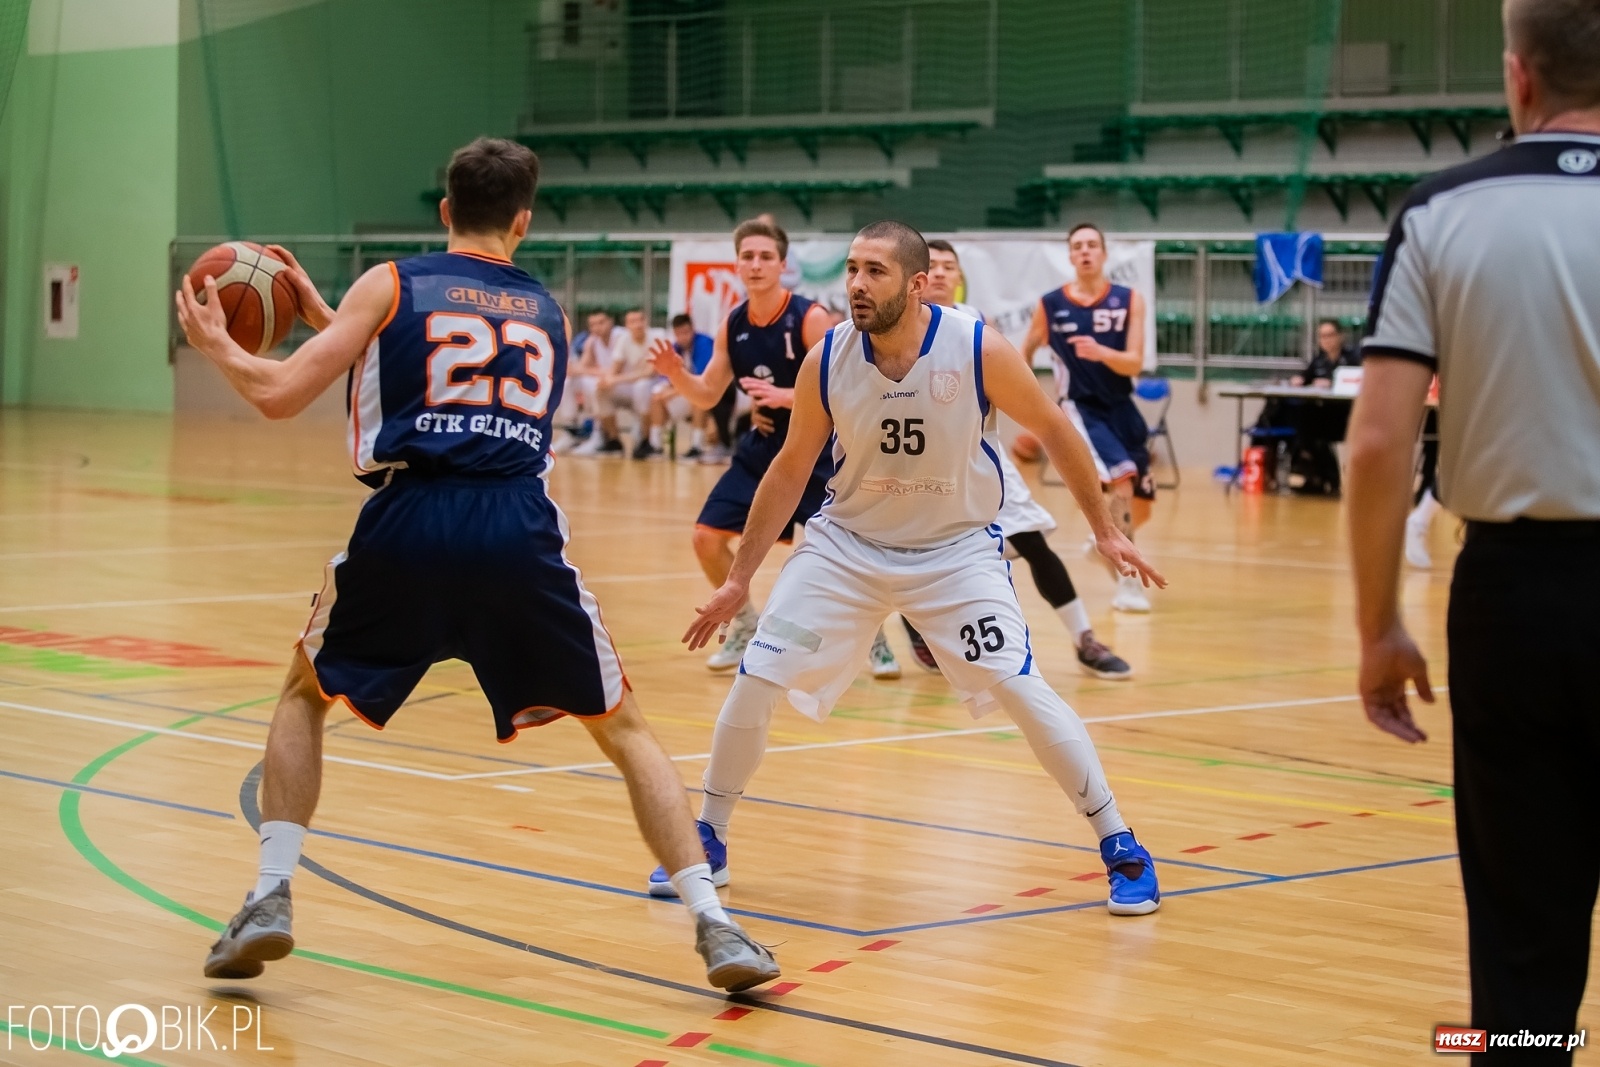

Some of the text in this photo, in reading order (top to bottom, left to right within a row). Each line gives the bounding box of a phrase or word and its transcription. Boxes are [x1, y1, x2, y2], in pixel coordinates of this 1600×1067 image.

[1092, 308, 1127, 333] 57
[424, 311, 554, 419] 23
[784, 332, 795, 360] 1
[415, 413, 543, 451] GTK GLIWICE
[880, 418, 926, 456] 35
[886, 484, 944, 494] KAMPKA
[959, 615, 1005, 663] 35
